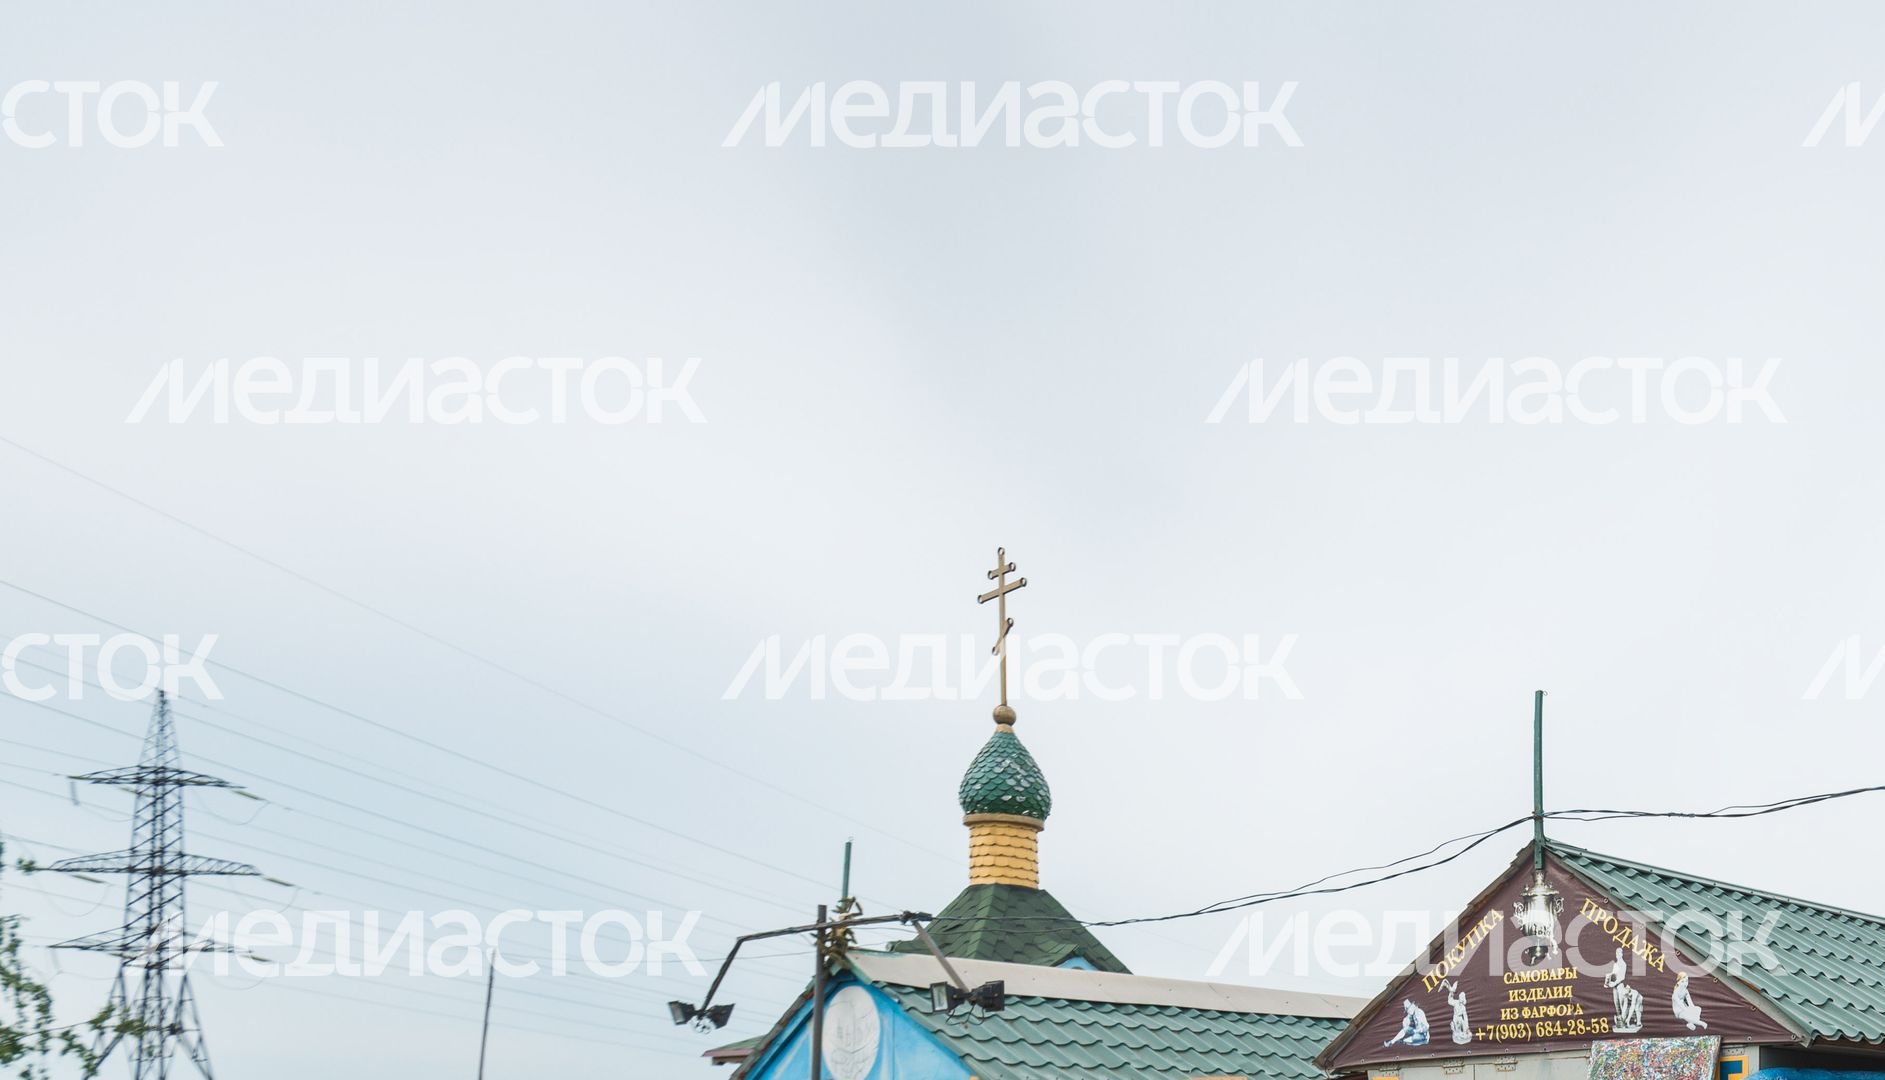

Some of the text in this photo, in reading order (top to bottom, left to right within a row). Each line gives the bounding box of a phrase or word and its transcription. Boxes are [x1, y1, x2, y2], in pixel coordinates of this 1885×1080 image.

[1579, 898, 1667, 973] ПРОДАЖА
[1421, 908, 1504, 993] ПОКУПКА
[1503, 967, 1578, 985] САМОВАРЫ
[1508, 985, 1574, 1003] ИЗДЕЛИЯ
[1500, 1003, 1584, 1021] ИЗ ФАРФОРА
[1475, 1017, 1610, 1043] +7(903) 684-28-58
